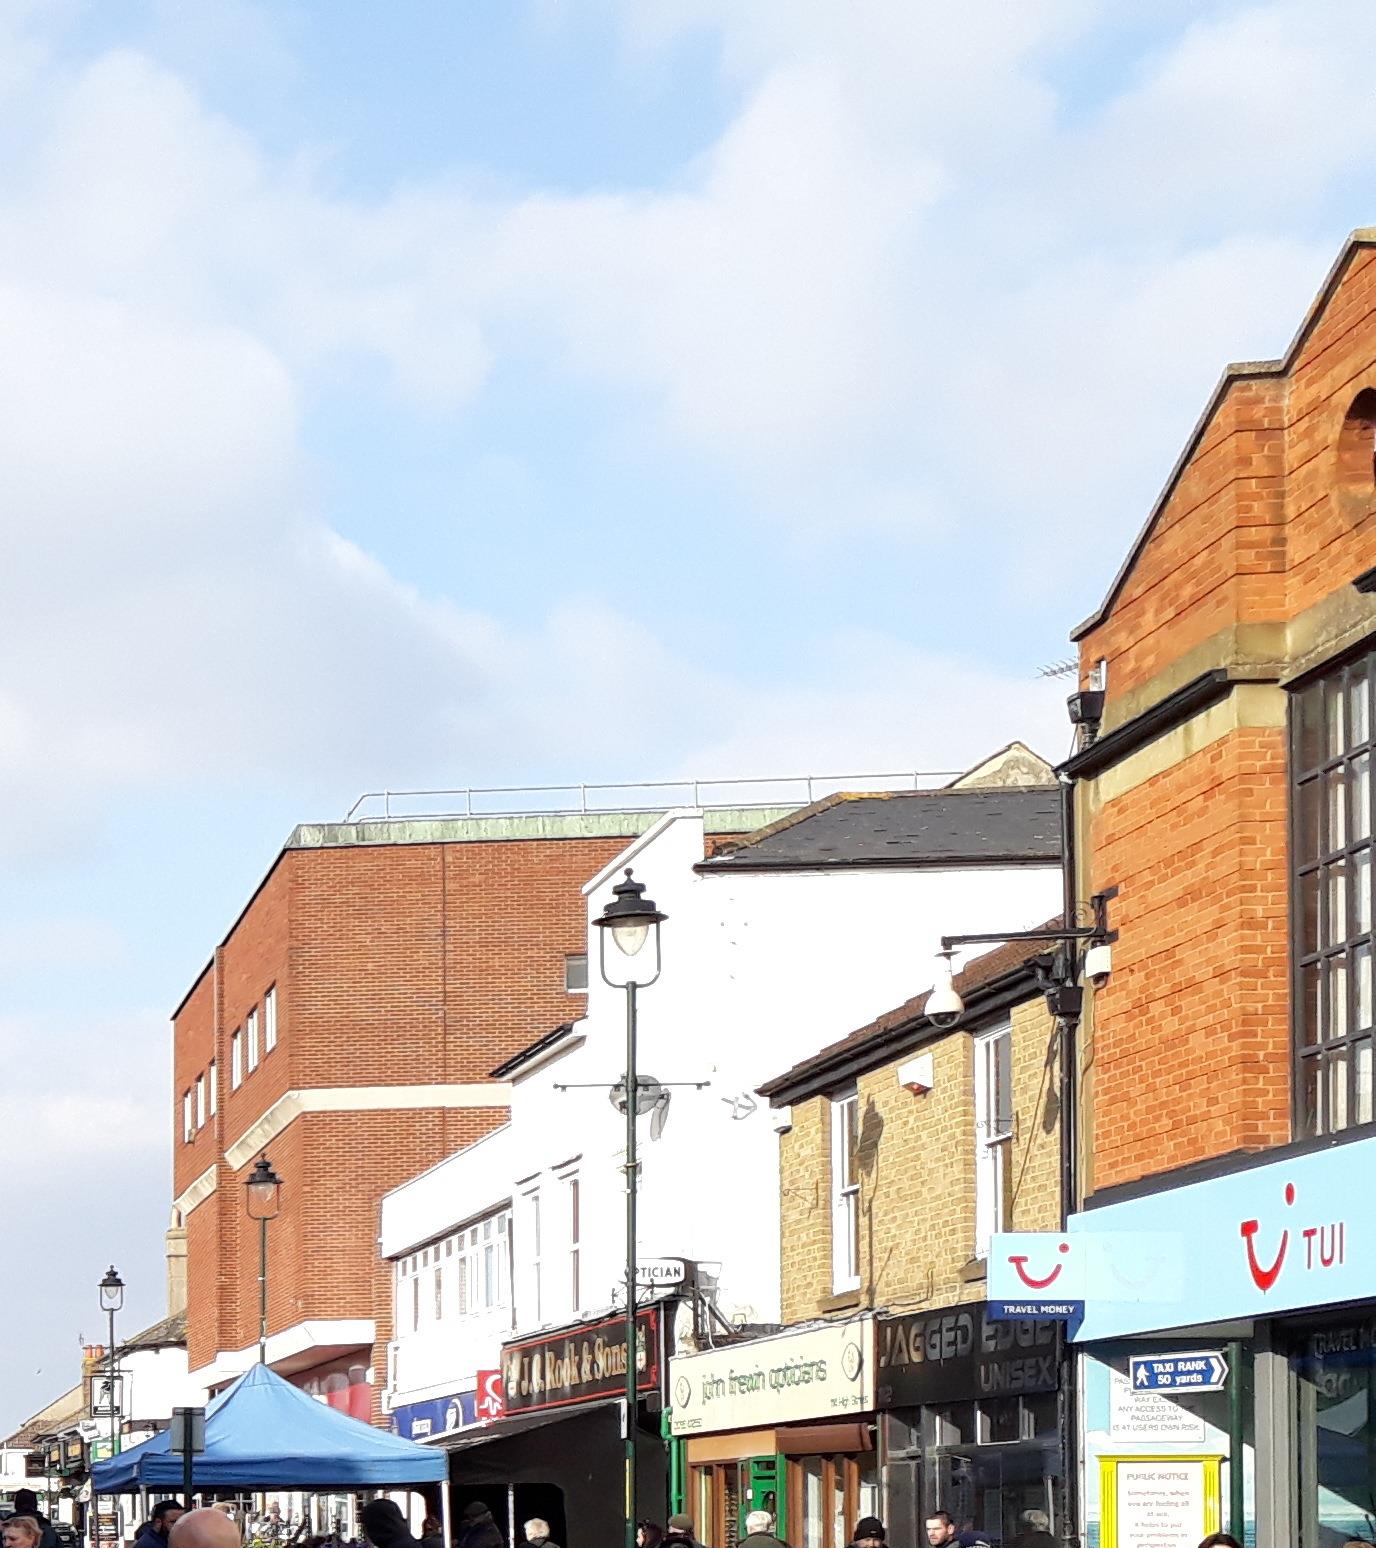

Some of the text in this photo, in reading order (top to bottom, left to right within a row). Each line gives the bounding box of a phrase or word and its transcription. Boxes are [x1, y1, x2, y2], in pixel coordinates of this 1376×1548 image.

[1303, 1222, 1345, 1270] TUI
[1004, 1304, 1076, 1315] TRAVEL MONEY
[879, 1312, 974, 1368] JAGGED
[546, 1342, 579, 1391] Rook
[593, 1337, 629, 1381] Sons
[980, 1356, 1057, 1392] UNISEX
[1152, 1360, 1207, 1373] TAXI RANK
[1157, 1373, 1203, 1386] 50 yards
